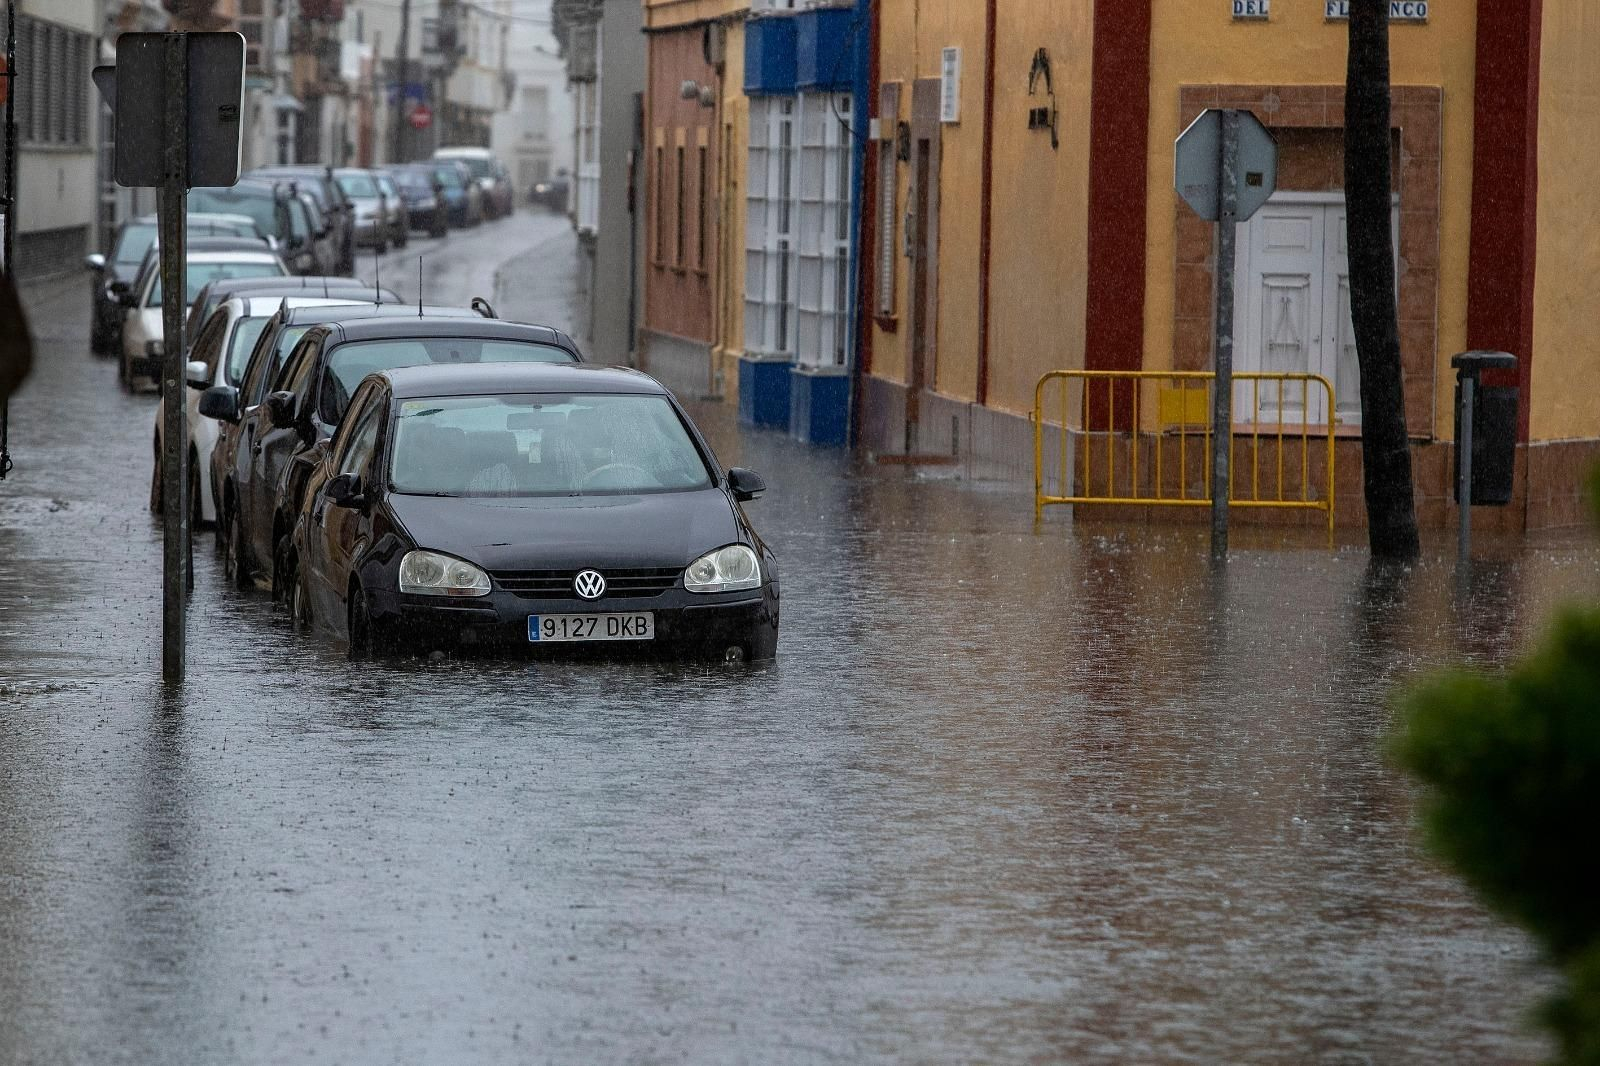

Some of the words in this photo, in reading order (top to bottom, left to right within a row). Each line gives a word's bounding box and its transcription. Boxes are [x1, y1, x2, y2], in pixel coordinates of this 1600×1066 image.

[1234, 0, 1268, 15] DEL
[1326, 1, 1427, 17] FLNCO
[575, 571, 606, 599] VW
[543, 617, 598, 638] 9127
[607, 616, 648, 637] DKB
